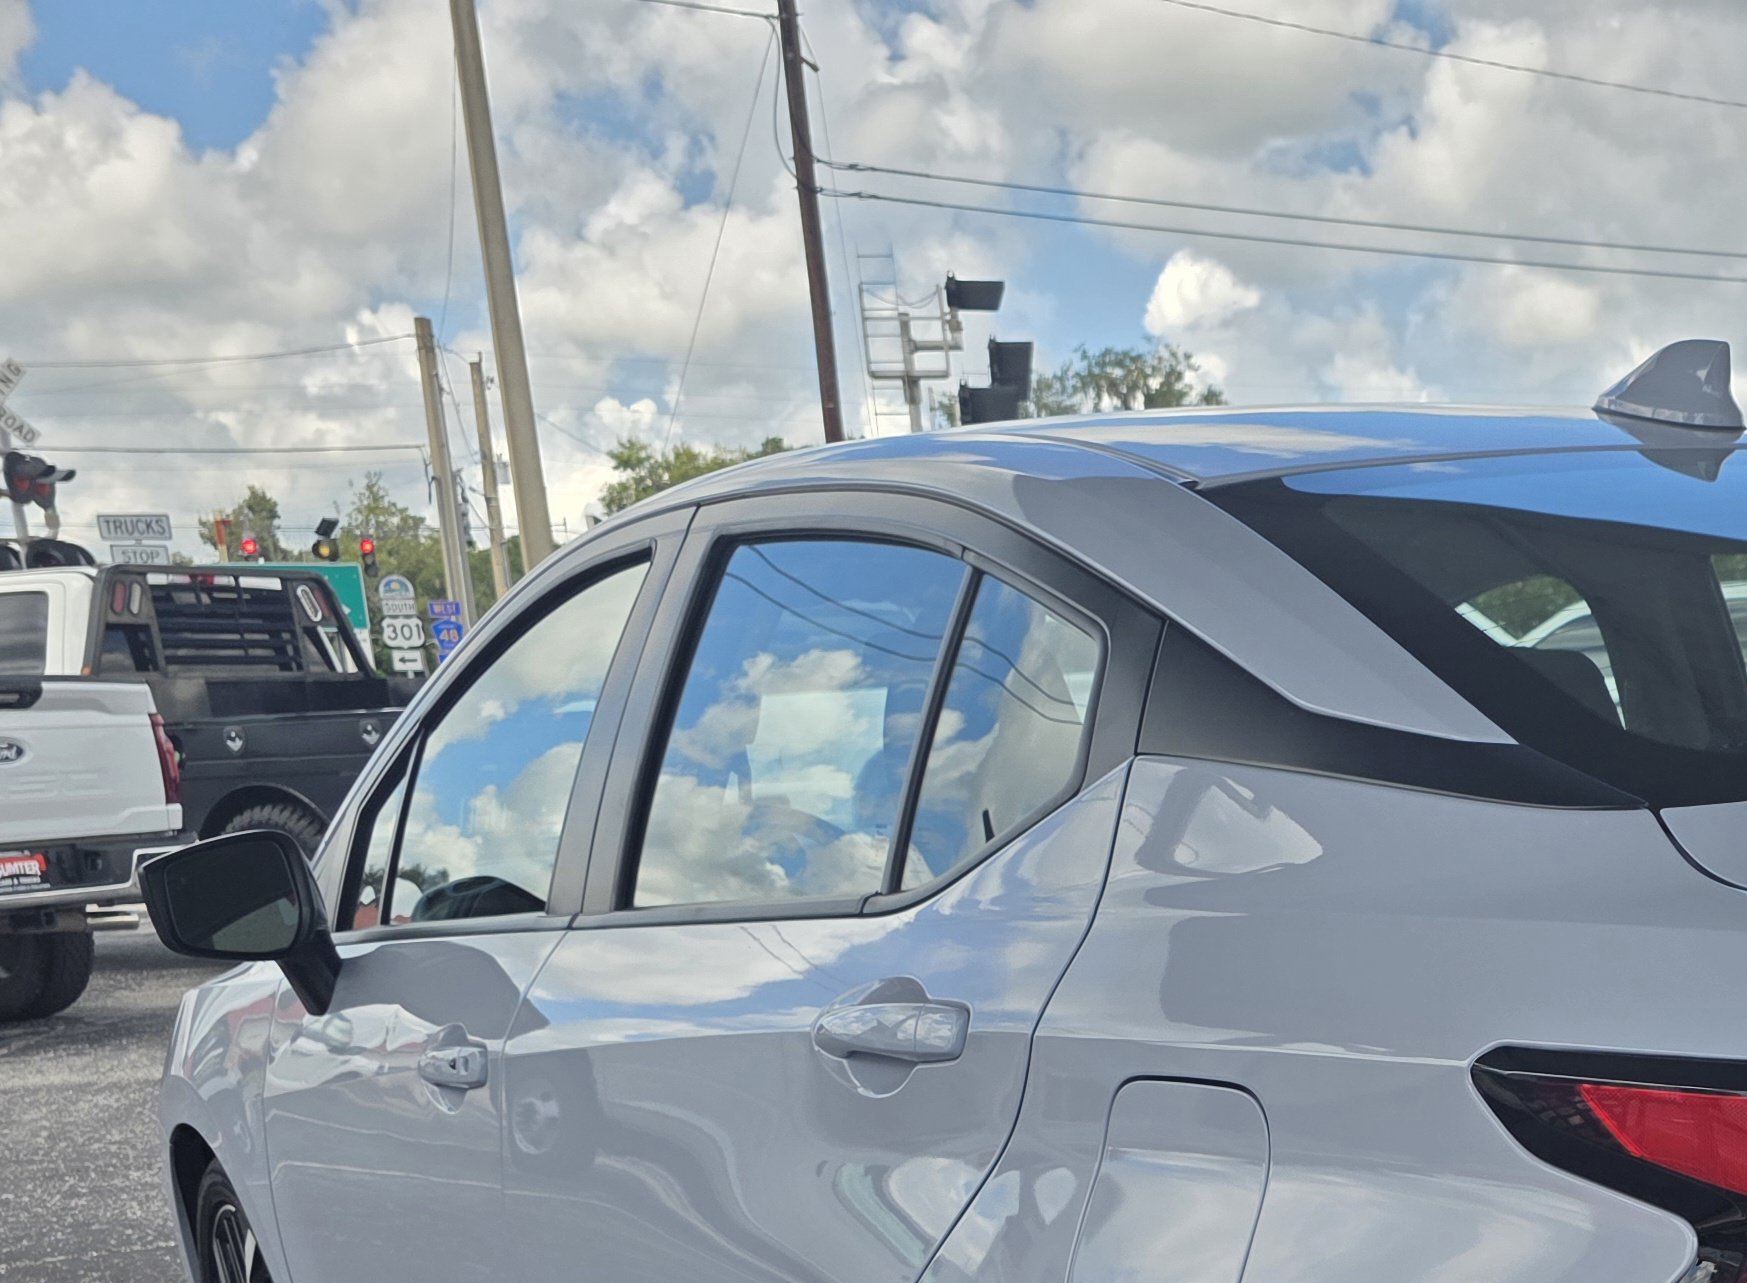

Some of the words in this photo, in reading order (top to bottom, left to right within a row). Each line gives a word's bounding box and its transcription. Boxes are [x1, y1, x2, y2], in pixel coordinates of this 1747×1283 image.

[103, 518, 166, 536] TRUCKS
[121, 549, 160, 563] STOP
[384, 602, 415, 614] SOUTH
[386, 623, 422, 641] 301
